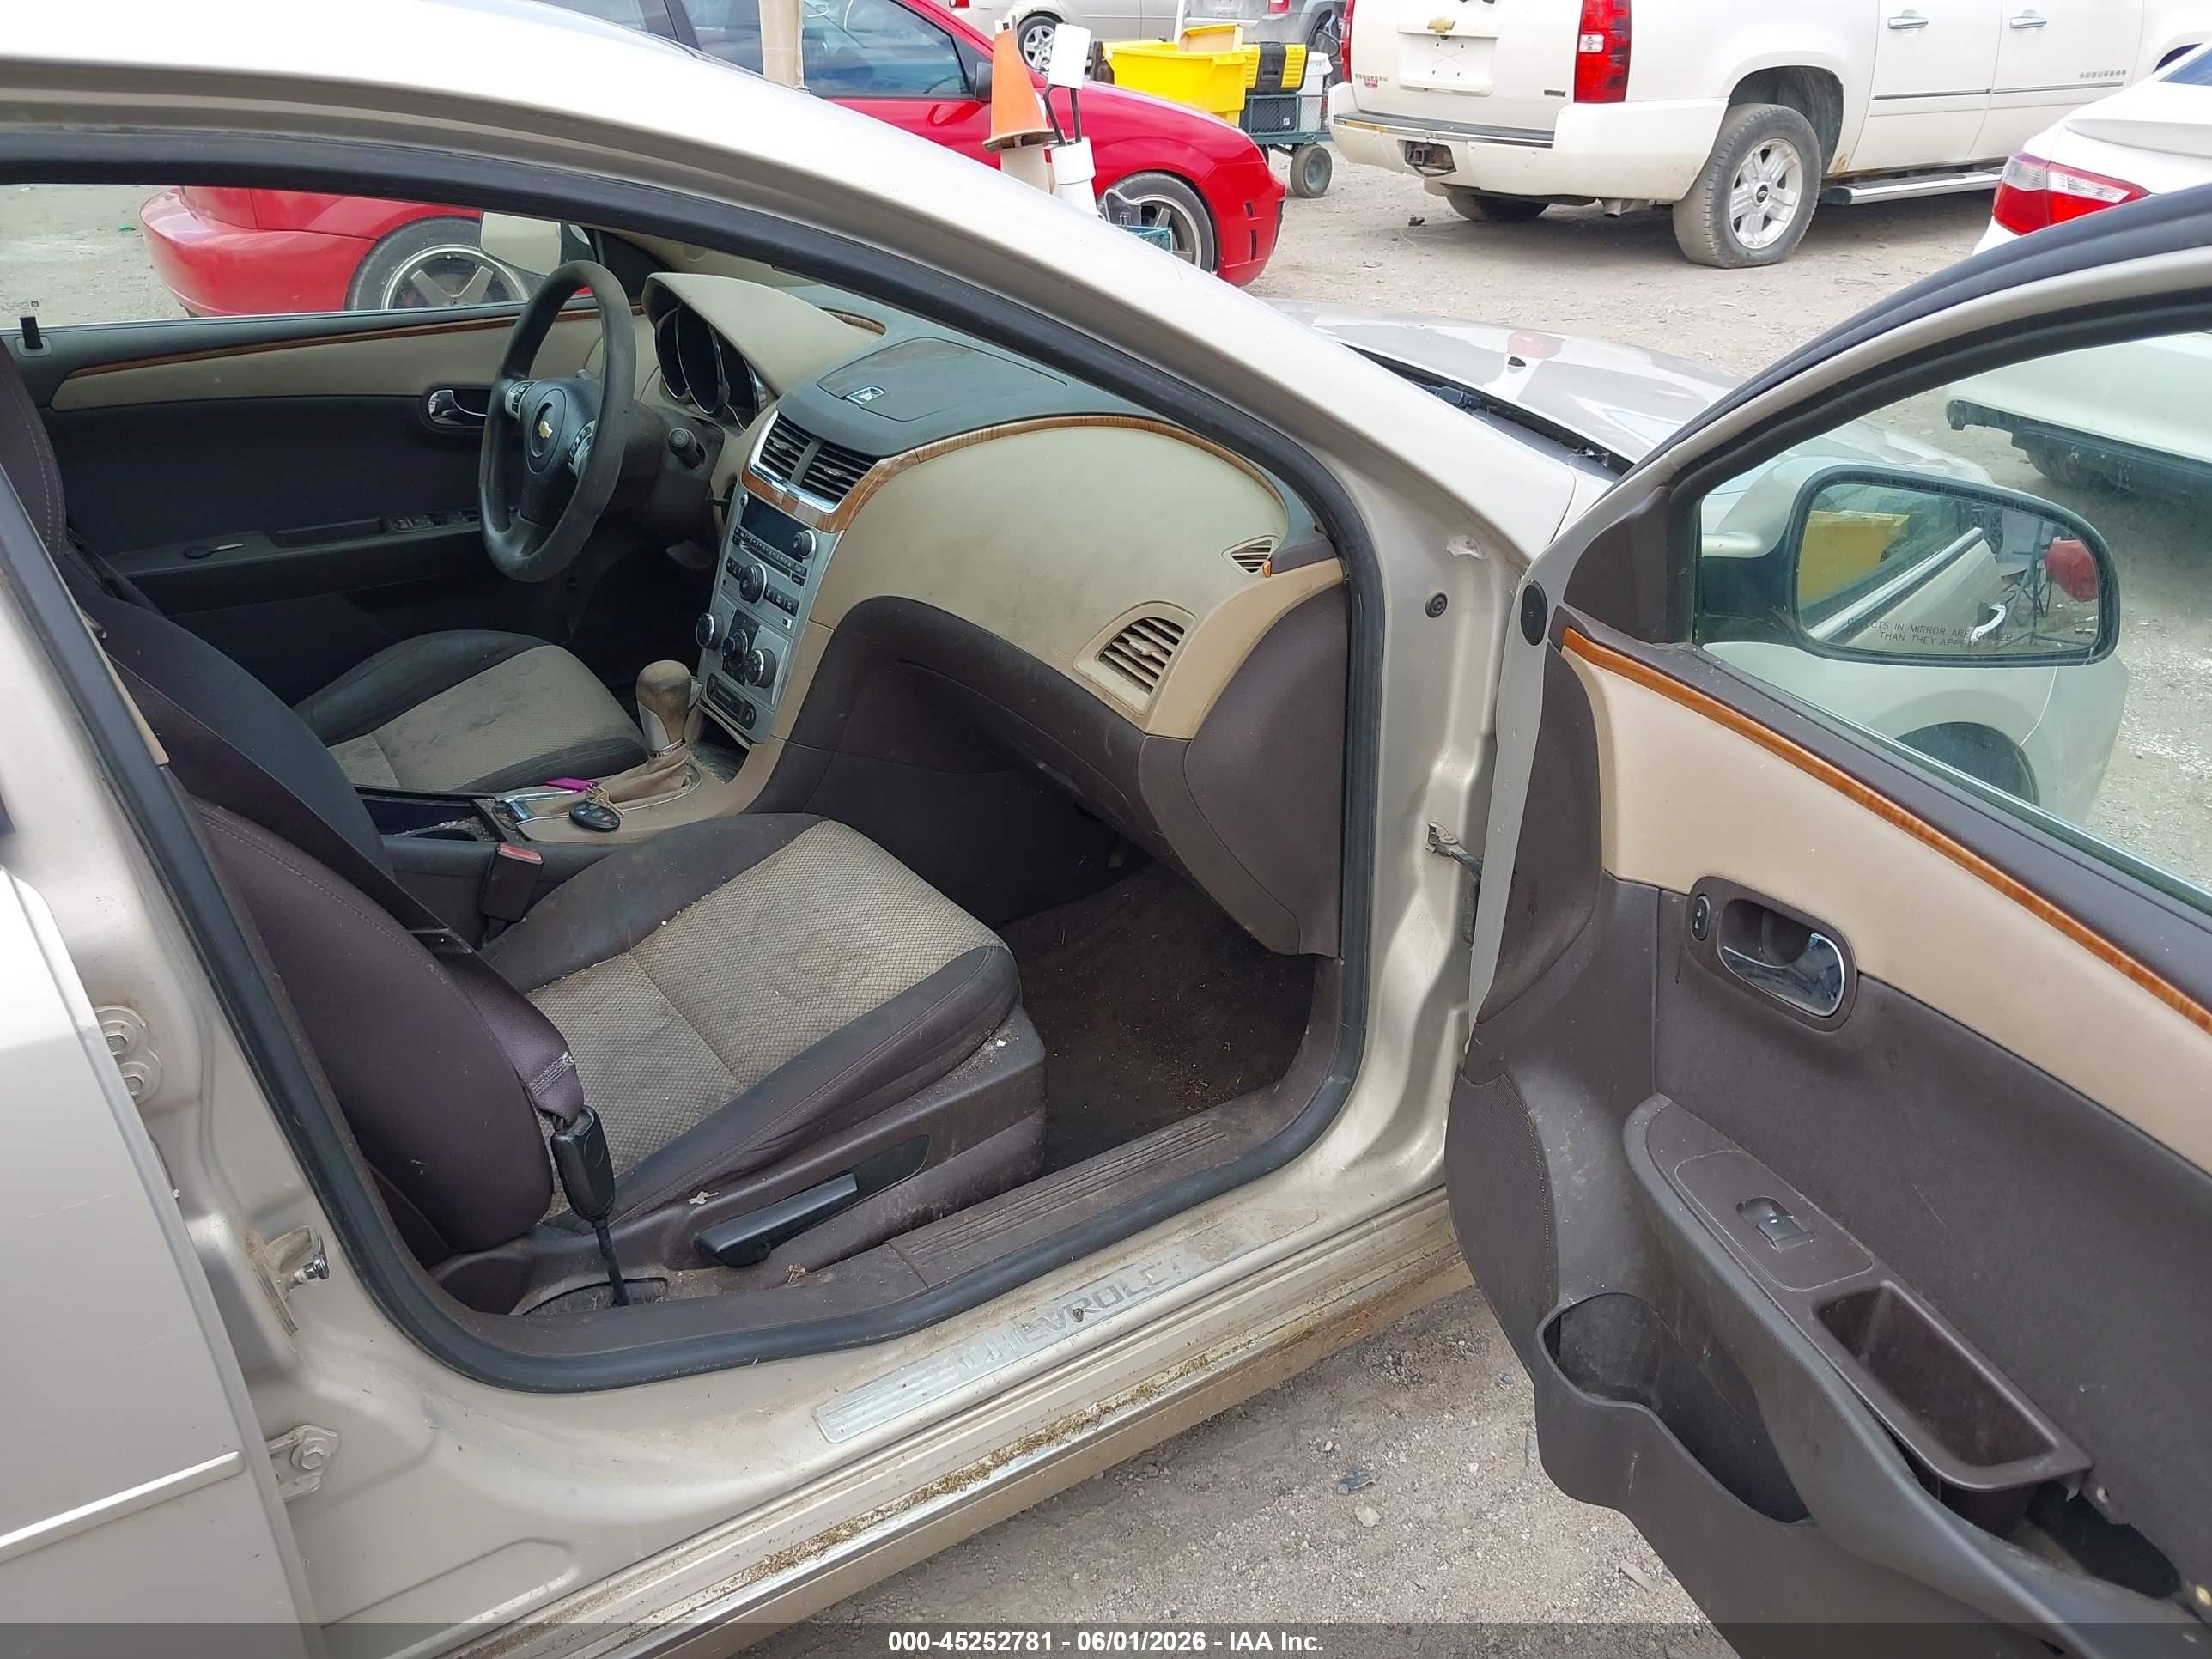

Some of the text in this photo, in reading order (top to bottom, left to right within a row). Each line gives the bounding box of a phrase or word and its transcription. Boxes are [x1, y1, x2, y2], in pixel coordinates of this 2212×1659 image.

[2079, 69, 2127, 79] SUBURBAN
[1847, 617, 1890, 630] OCTS
[1894, 623, 1905, 632] IN
[1909, 624, 1947, 636] MIRROR
[1950, 629, 1971, 640] ARE
[1880, 631, 1906, 642] THAN
[1909, 635, 1938, 646] THEY
[960, 1255, 1183, 1370] CHEVROLE
